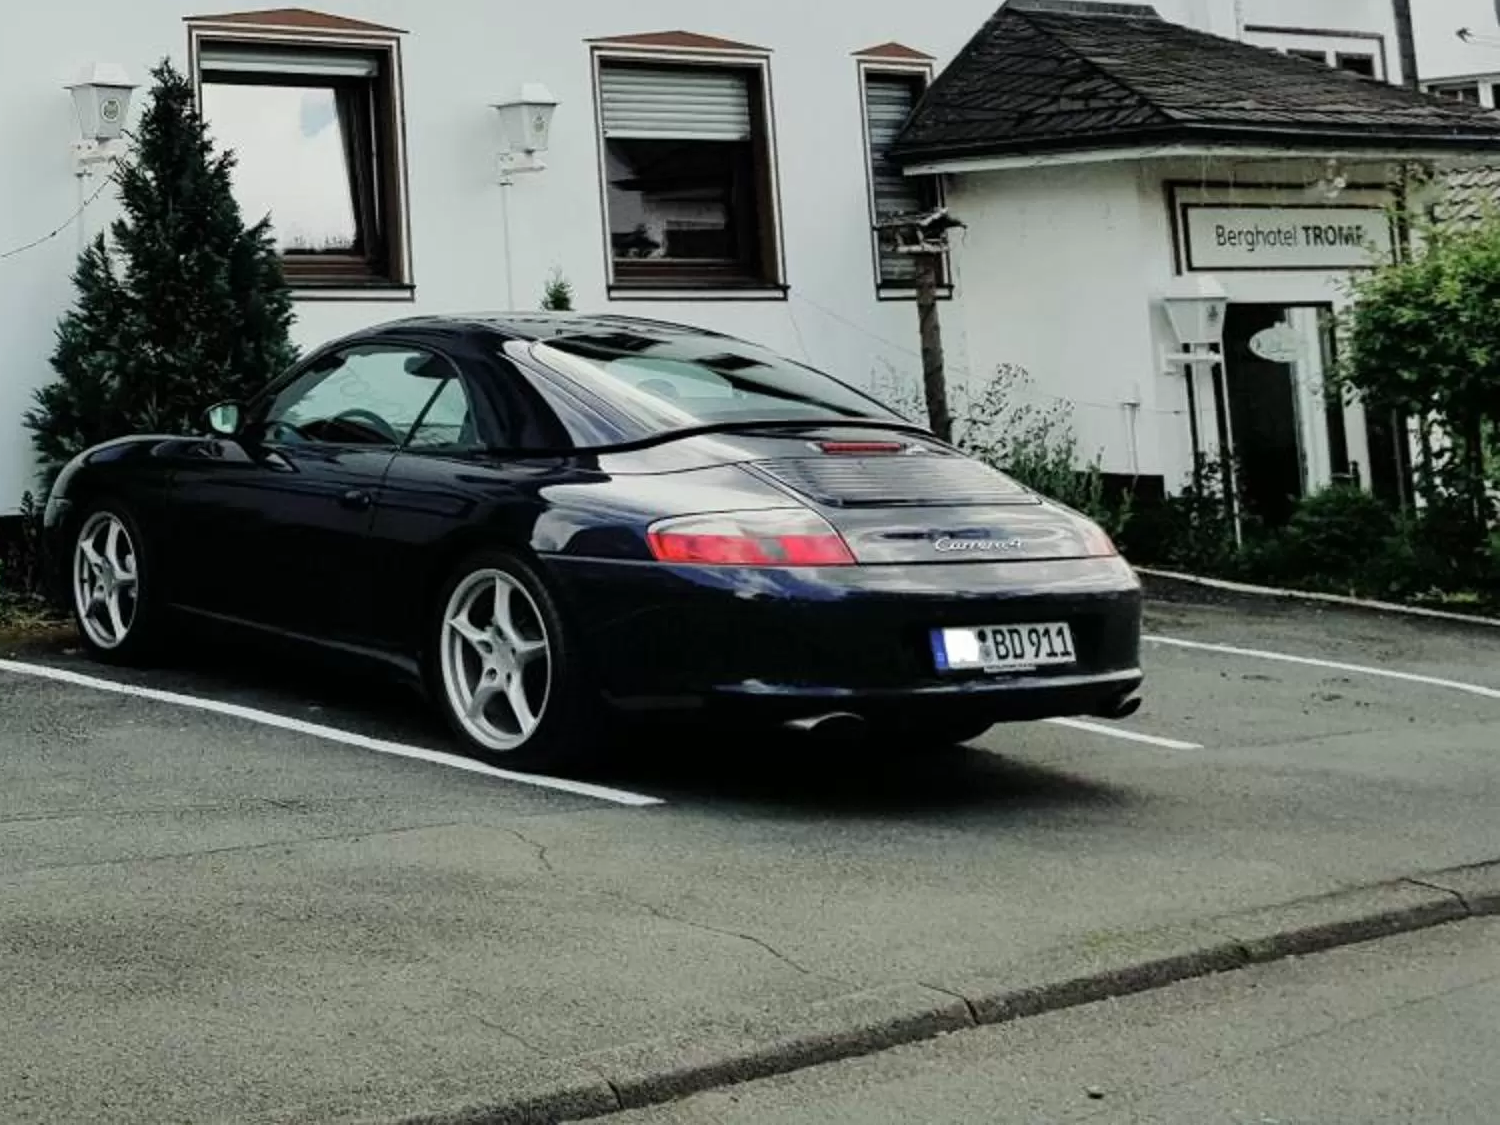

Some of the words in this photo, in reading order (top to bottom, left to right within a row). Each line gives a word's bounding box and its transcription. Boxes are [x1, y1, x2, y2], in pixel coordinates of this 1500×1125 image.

[1215, 225, 1297, 251] Berghotel
[991, 628, 1025, 659] BD
[1028, 626, 1072, 658] 911
